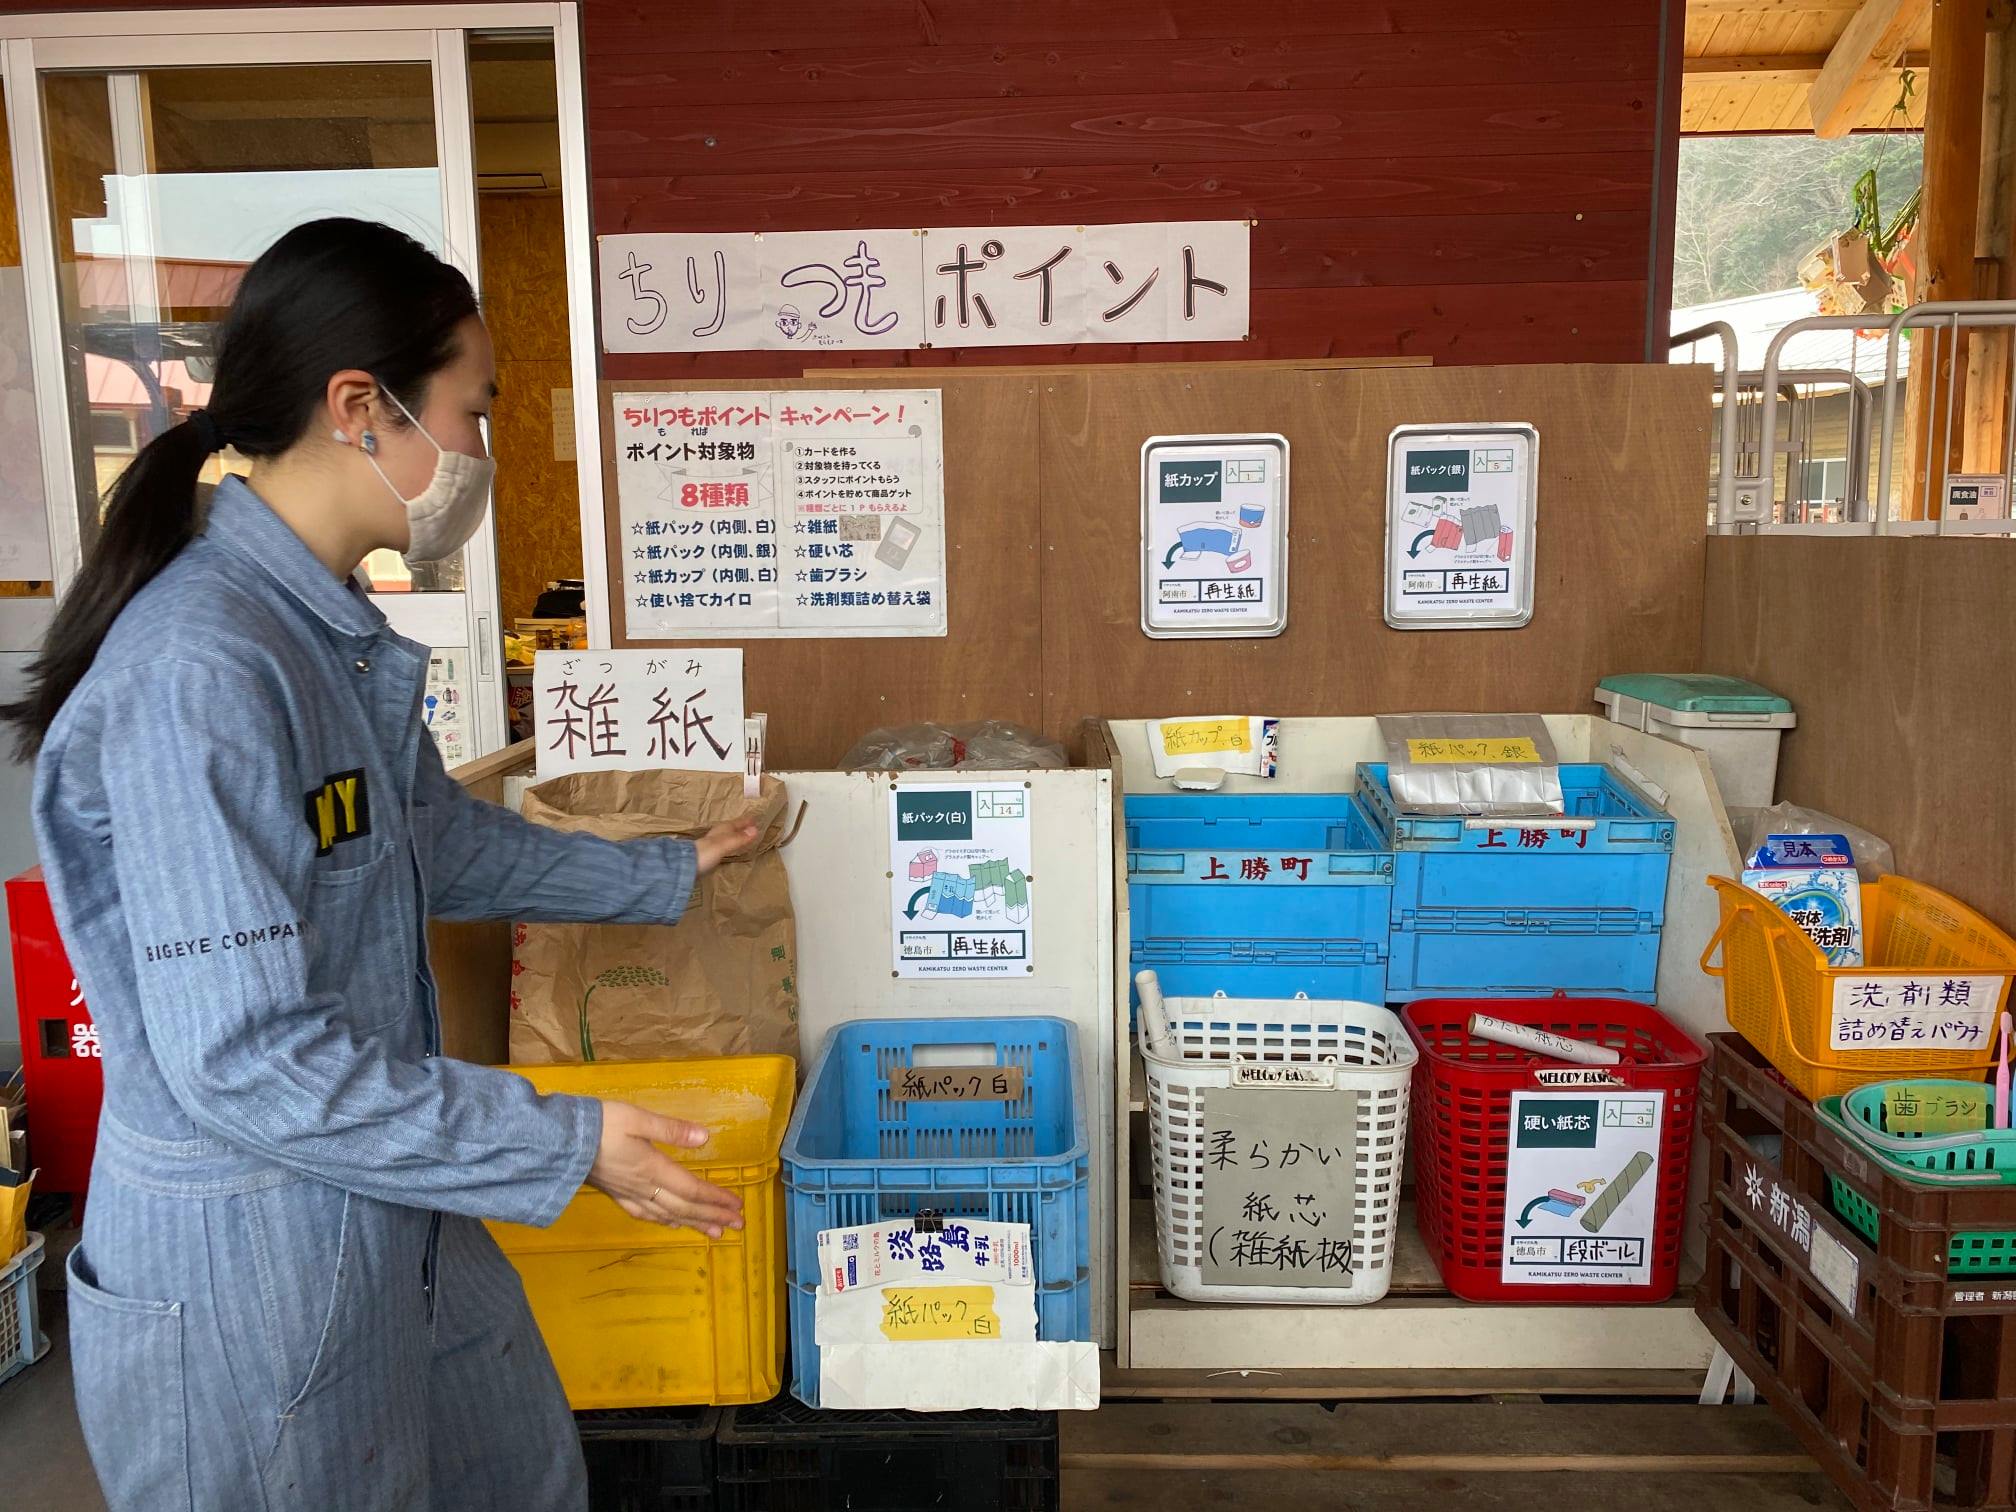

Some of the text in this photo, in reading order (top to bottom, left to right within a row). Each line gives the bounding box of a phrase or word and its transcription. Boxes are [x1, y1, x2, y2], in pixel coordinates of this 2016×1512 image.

[623, 405, 770, 427] ちりつもポイント
[626, 441, 755, 462] ポイント対象物
[1475, 456, 1485, 466] 入
[1493, 462, 1500, 470] 5
[1228, 467, 1237, 477] 入
[1410, 464, 1466, 477] 紙パック(銀)
[1164, 471, 1219, 488] 紙カップ
[680, 482, 750, 508] 8種類
[807, 519, 838, 535] 雑紙
[808, 544, 854, 559] 硬い芯
[809, 568, 868, 583] 歯ブラシ
[1451, 572, 1500, 591] 再生紙
[810, 590, 932, 608] 洗剤類詰め替え袋
[1204, 582, 1255, 600] 再生紙
[649, 592, 753, 609] 使い捨てカイロ
[561, 658, 704, 678] ざつがみ
[546, 679, 733, 761] 雑紙
[979, 799, 991, 811] 入
[999, 806, 1012, 815] 14
[902, 811, 967, 825] 紙パック(白)
[1476, 828, 1588, 849] 上勝町
[1783, 841, 1818, 858] 見本
[1200, 857, 1313, 881] 上勝町
[1790, 911, 1822, 927] 液体
[146, 937, 212, 962] BIGEYE
[903, 944, 932, 956] 徳島市
[953, 936, 1013, 959] 再生紙
[1850, 980, 1971, 1007] 洗剤類
[1839, 1016, 1982, 1042] 詰め替えパウチ
[1539, 1072, 1581, 1084] MELODY
[1892, 1087, 1977, 1117] 歯ブラシ
[1606, 1108, 1618, 1119] 入
[1637, 1116, 1644, 1125] 3
[1523, 1115, 1591, 1131] 硬い紙芯
[1208, 1130, 1341, 1170] 柔らかい
[1242, 1192, 1327, 1227] 紙芯
[1770, 1182, 1811, 1253] 新潟
[887, 1225, 970, 1272] 淡路島
[974, 1235, 990, 1267] 牛乳
[1516, 1246, 1547, 1257] 徳島市
[1566, 1239, 1635, 1262] 段ボール
[1528, 1271, 1623, 1279] KAMIKATSU ZERO WASTE CENTER
